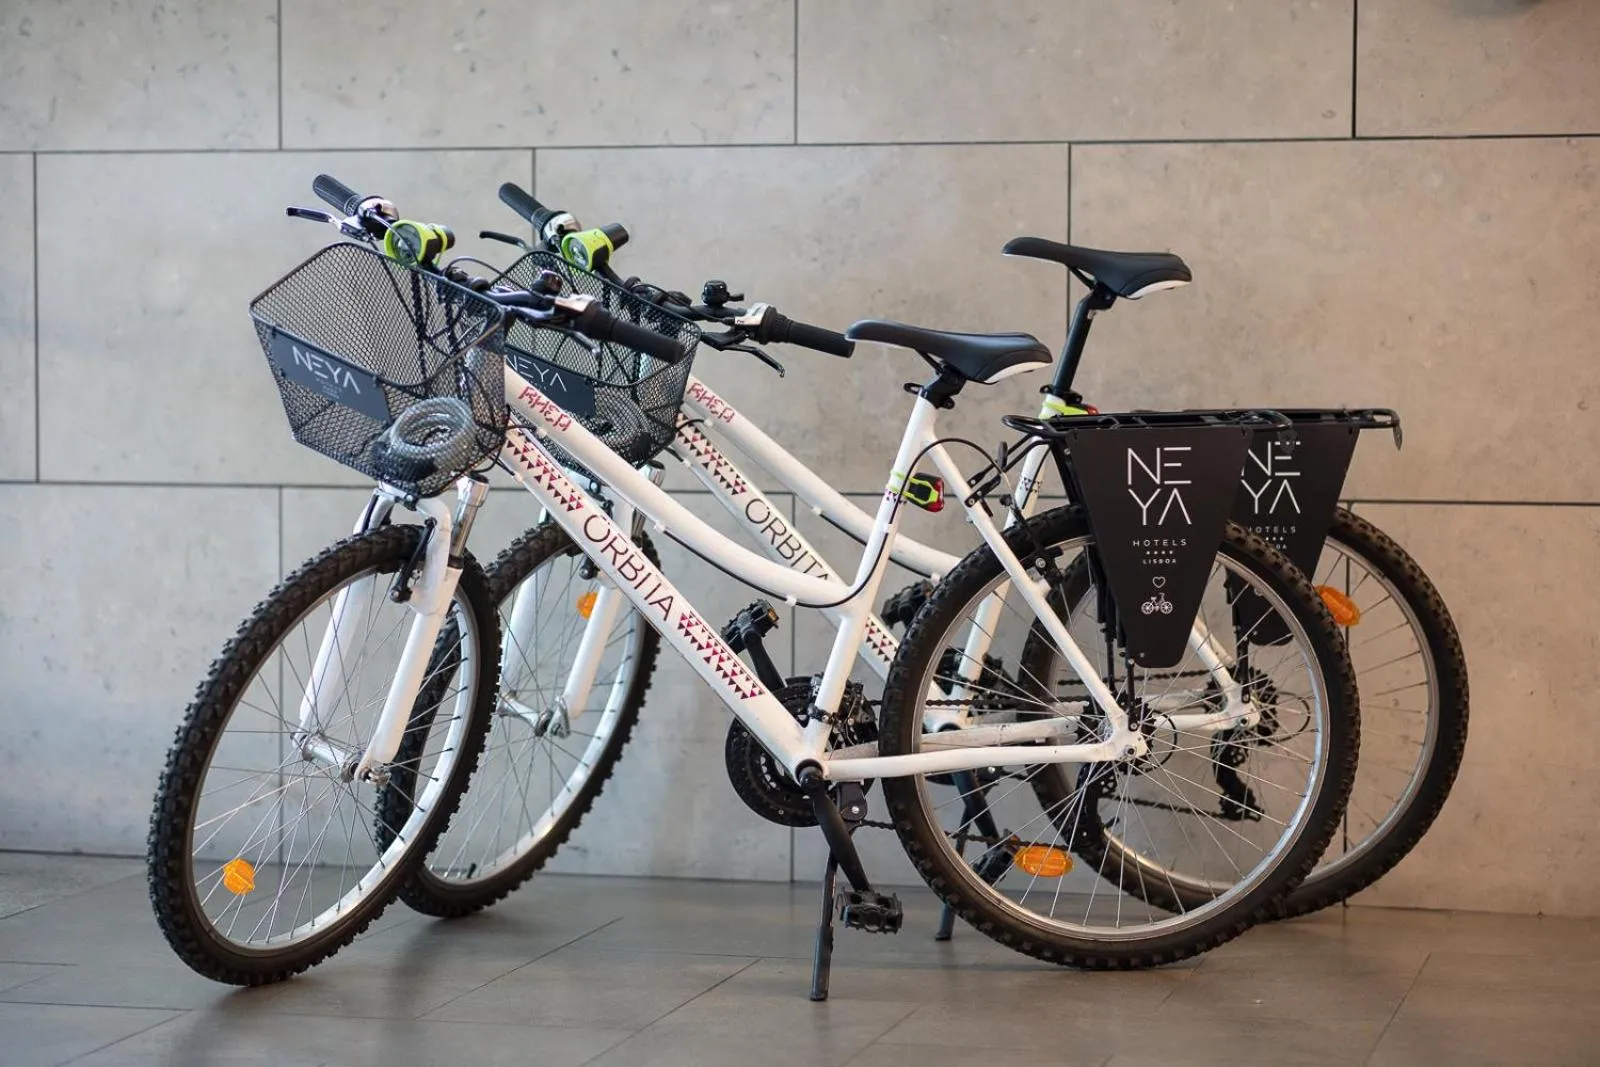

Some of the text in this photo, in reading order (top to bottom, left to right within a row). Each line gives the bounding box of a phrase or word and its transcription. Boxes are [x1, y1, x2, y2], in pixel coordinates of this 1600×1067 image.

[291, 345, 362, 395] NEYA
[583, 513, 675, 622] ORBITA
[1132, 538, 1188, 547] HOTELS
